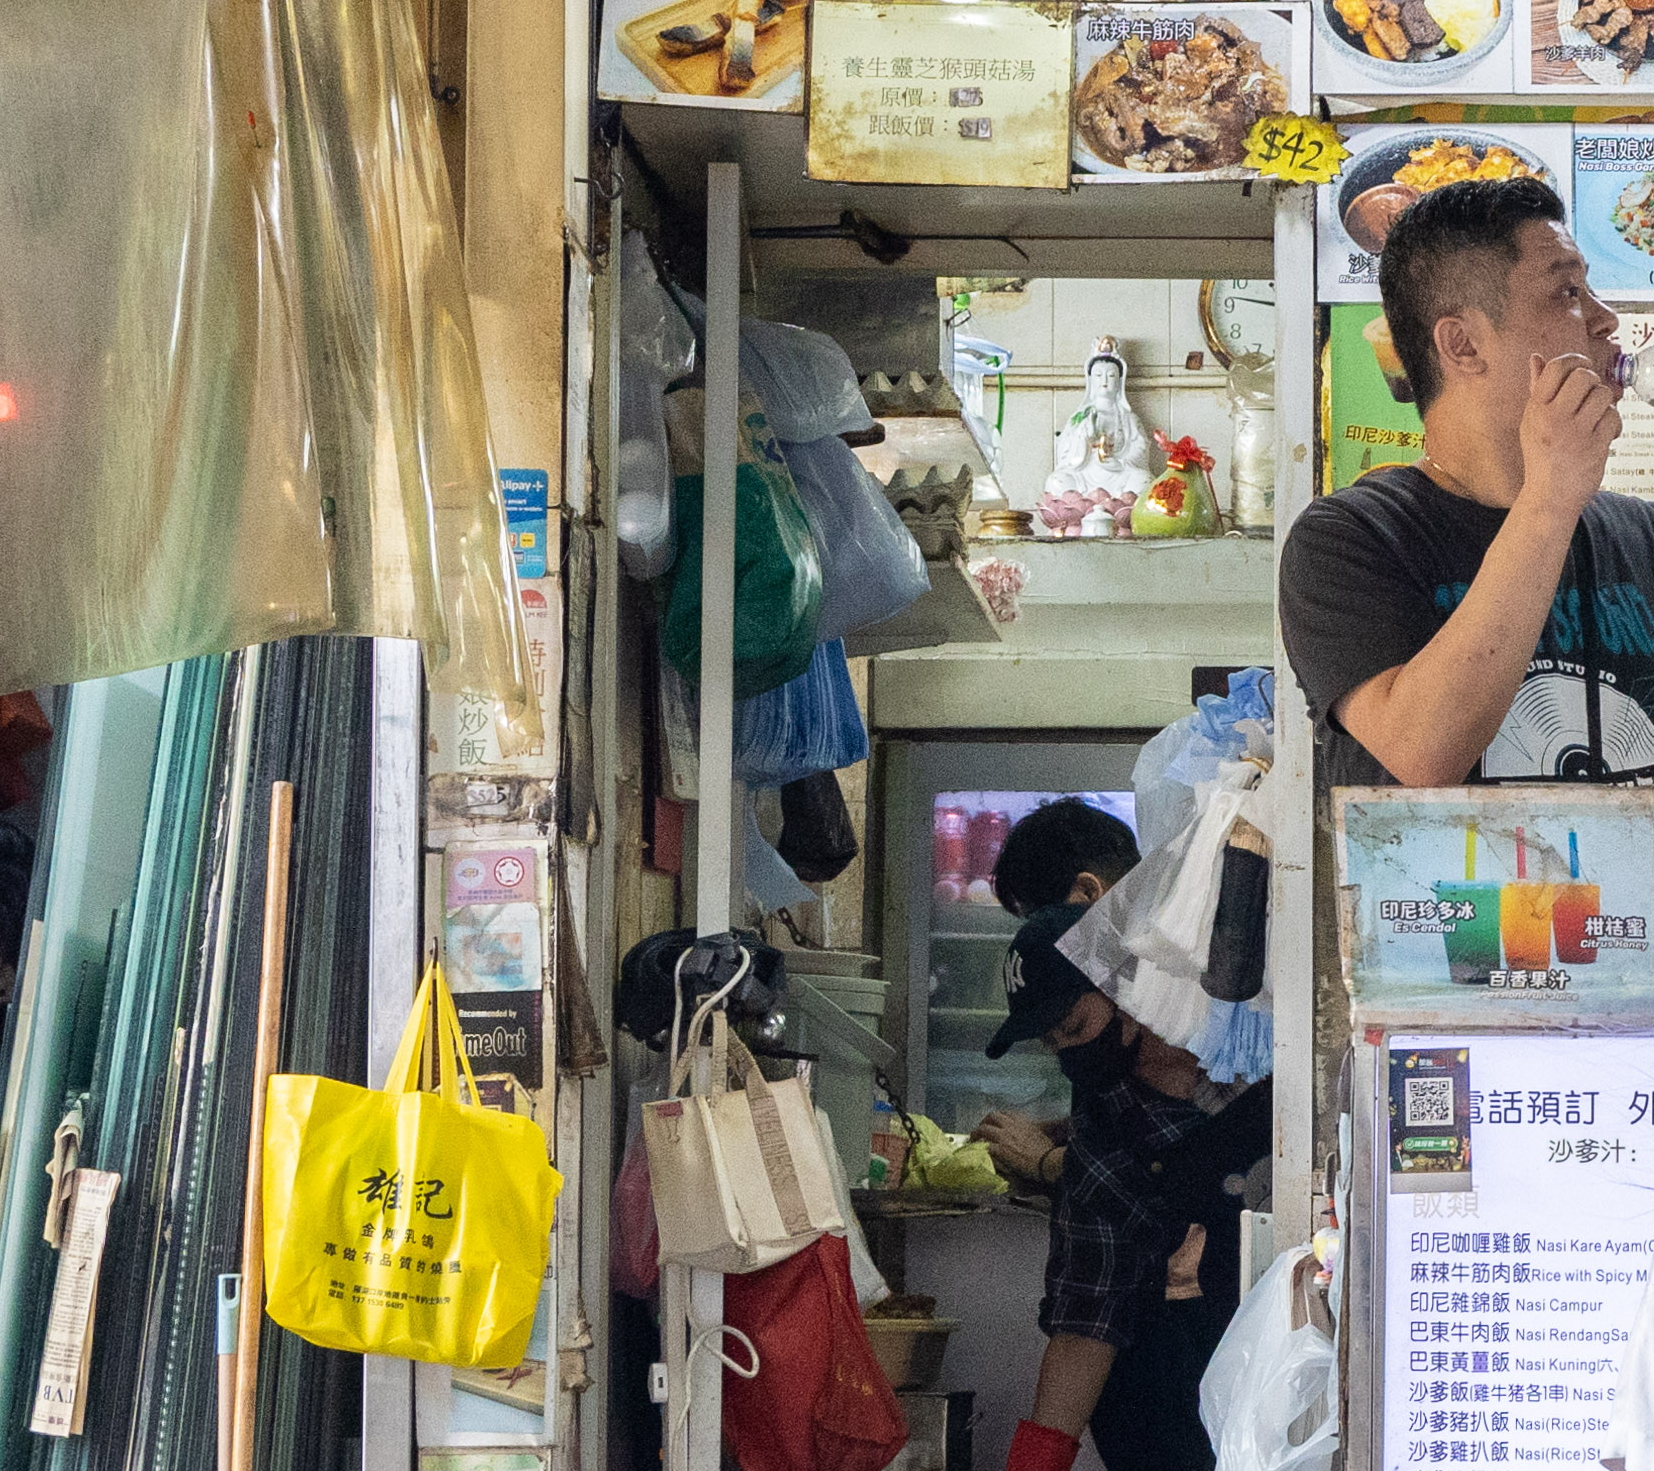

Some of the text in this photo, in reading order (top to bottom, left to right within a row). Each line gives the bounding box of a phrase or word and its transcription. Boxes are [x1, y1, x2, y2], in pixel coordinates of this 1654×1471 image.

[1086, 18, 1196, 42] 麻辣牛筋肉
[1258, 127, 1327, 174] $42
[1381, 901, 1475, 920] 印尼珍多冰
[1411, 922, 1457, 933] Cendol
[1489, 970, 1570, 988] 百香果汁
[358, 1168, 453, 1220] 雄記
[1537, 1239, 1566, 1253] Nasi
[1571, 1239, 1601, 1253] Kare
[1410, 1292, 1603, 1314] 印尼雜錦飯 Nasi Campur
[1409, 1411, 1509, 1432] 沙爹豬扒飯
